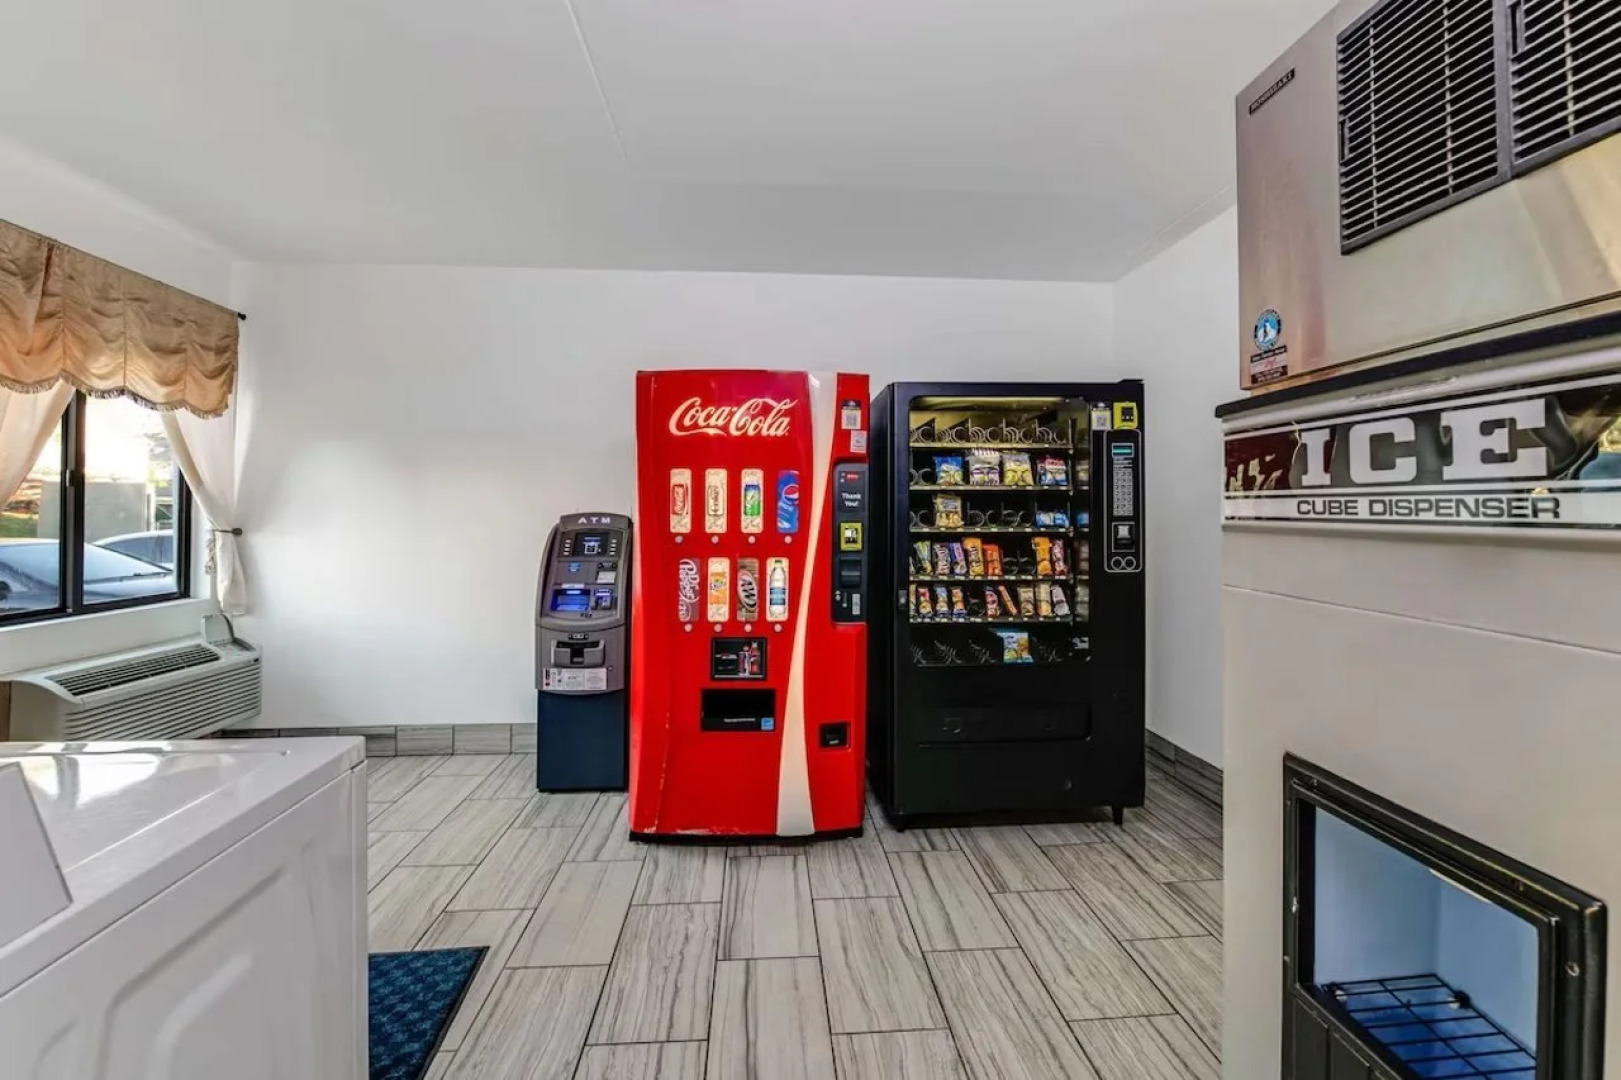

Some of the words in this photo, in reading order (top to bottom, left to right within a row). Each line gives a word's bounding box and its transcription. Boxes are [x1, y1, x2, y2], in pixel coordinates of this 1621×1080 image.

[668, 397, 799, 436] Coca-Cola
[1301, 399, 1547, 486] ICE
[842, 492, 861, 500] Thank
[1297, 499, 1359, 516] CUBE
[1369, 497, 1560, 518] DISPENSER
[578, 516, 611, 524] ATM
